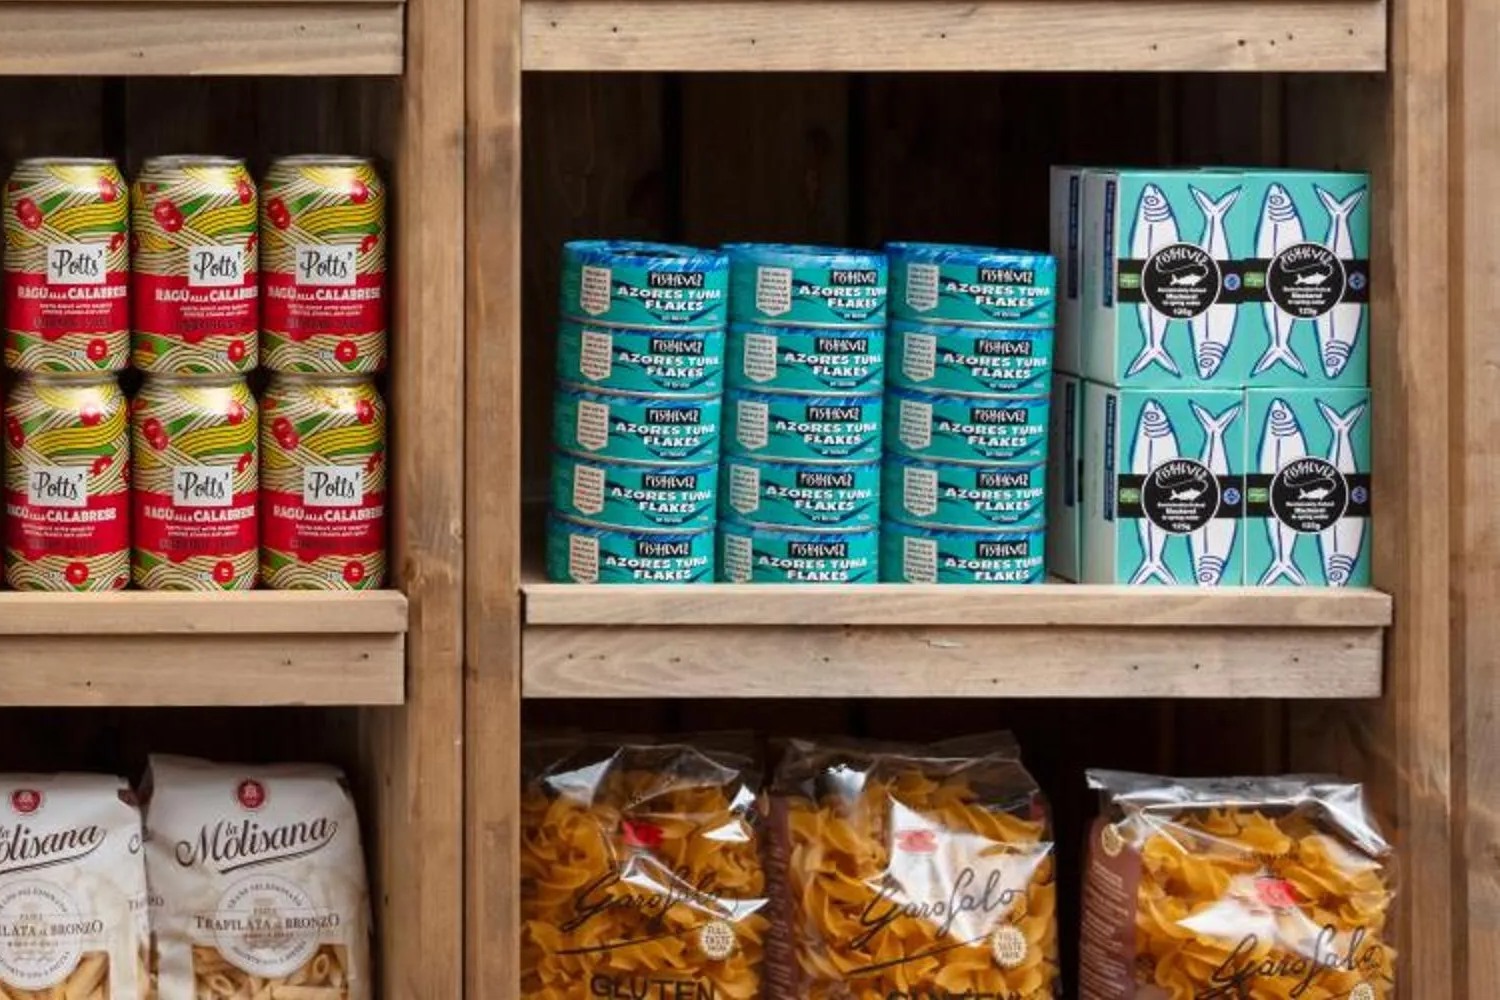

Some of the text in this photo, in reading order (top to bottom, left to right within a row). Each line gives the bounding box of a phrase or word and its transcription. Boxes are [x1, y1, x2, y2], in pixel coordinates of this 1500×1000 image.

[52, 250, 104, 278] Potts'
[68, 284, 127, 299] CALABRESE
[617, 285, 682, 299] AZORES
[945, 282, 1013, 296] AZORES
[645, 299, 704, 311] FLAKES
[975, 294, 1034, 308] FLAKES
[46, 507, 116, 522] CALABRESE
[194, 506, 255, 522] CALABRESE
[606, 556, 671, 569] AZORES
[633, 568, 692, 580] FLAKES
[175, 817, 338, 868] Molisana
[50, 919, 103, 936] BRONZO
[195, 913, 340, 931] TRAFILATA BRONZO
[590, 974, 715, 1000] GLUTEN
